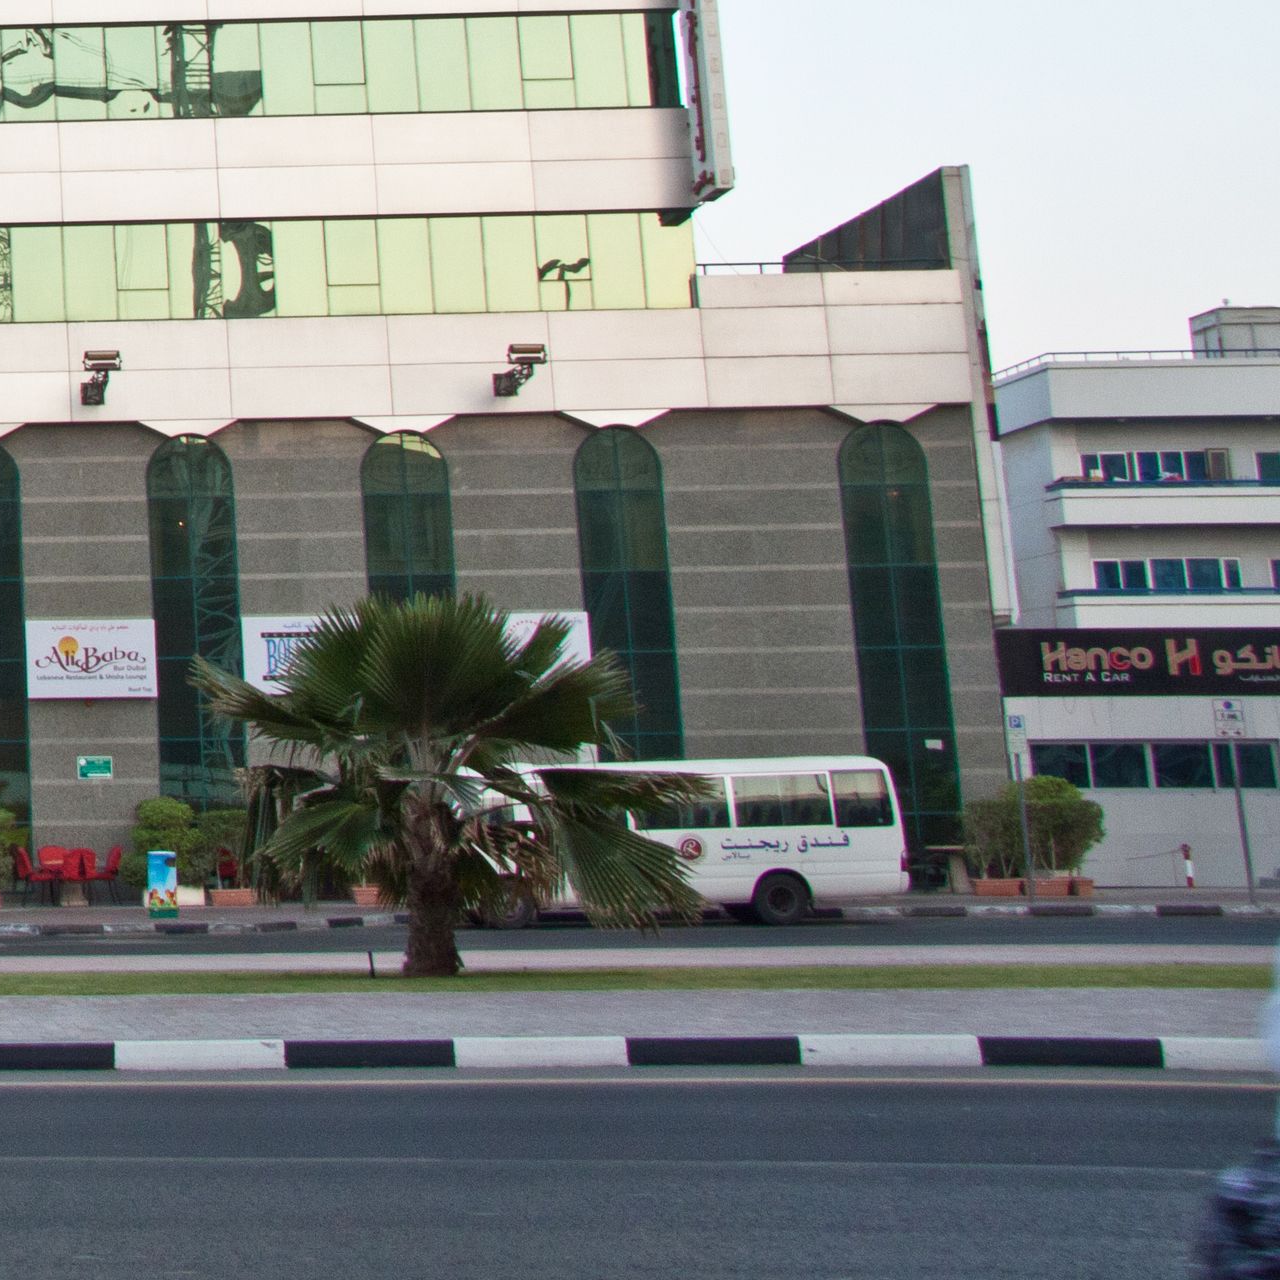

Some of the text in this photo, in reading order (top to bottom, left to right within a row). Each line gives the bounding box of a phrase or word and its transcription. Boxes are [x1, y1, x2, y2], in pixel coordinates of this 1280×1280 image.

[1041, 641, 1153, 671] Hanco
[1212, 644, 1280, 676] انكو
[1044, 672, 1131, 682] RENT A CAR
[721, 831, 850, 853] فندق ريجنت
